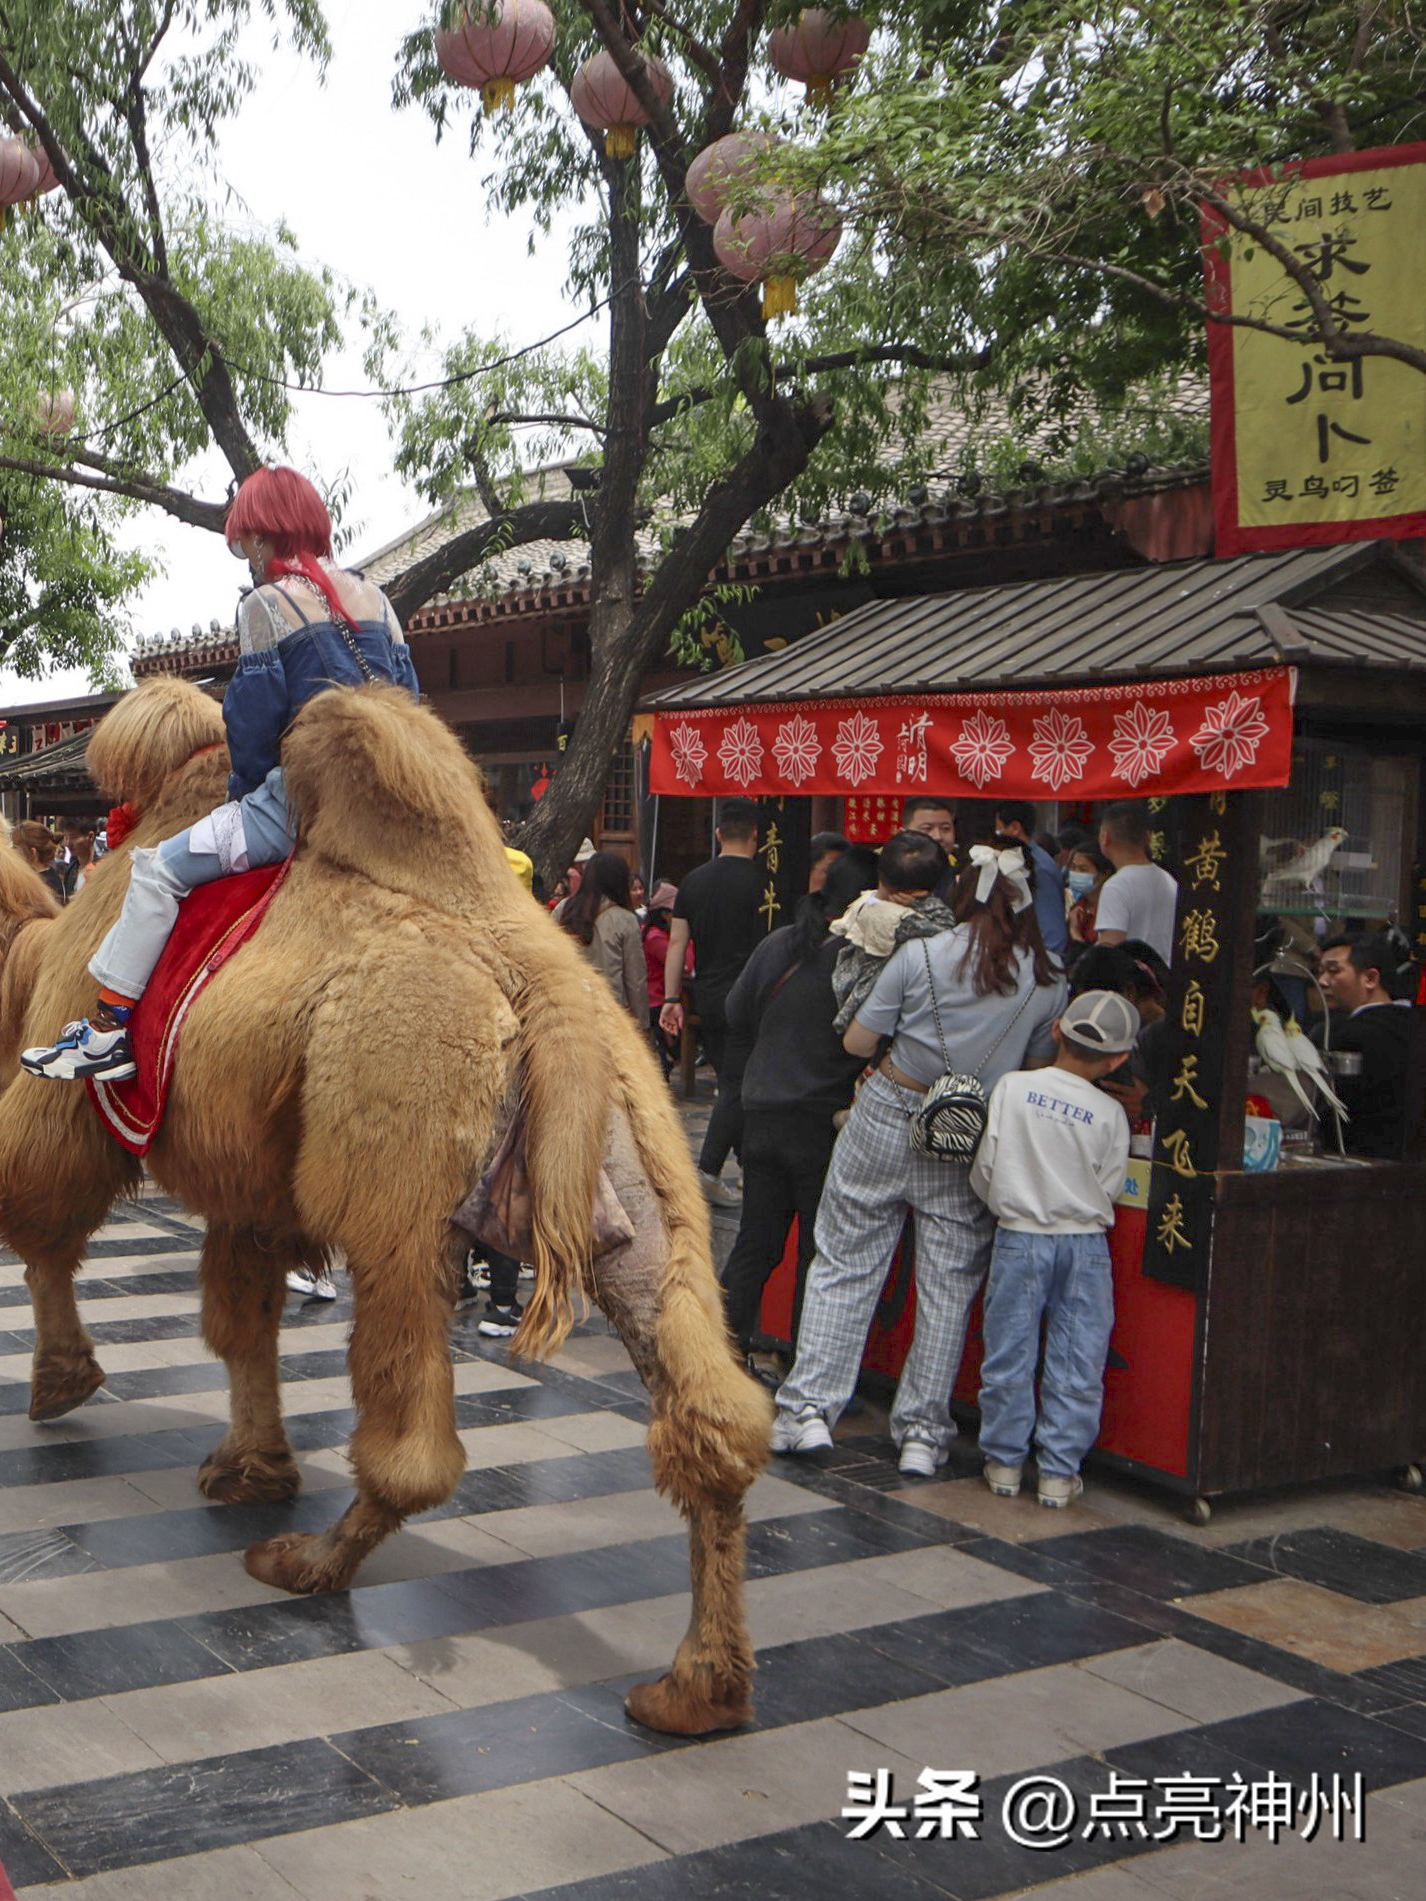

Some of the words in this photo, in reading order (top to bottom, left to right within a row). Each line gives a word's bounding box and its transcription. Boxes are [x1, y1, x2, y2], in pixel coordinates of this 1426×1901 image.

[1264, 187, 1393, 224] 民间技艺
[1262, 466, 1400, 502] 灵鸟叼签
[1027, 1090, 1095, 1126] BETTER
